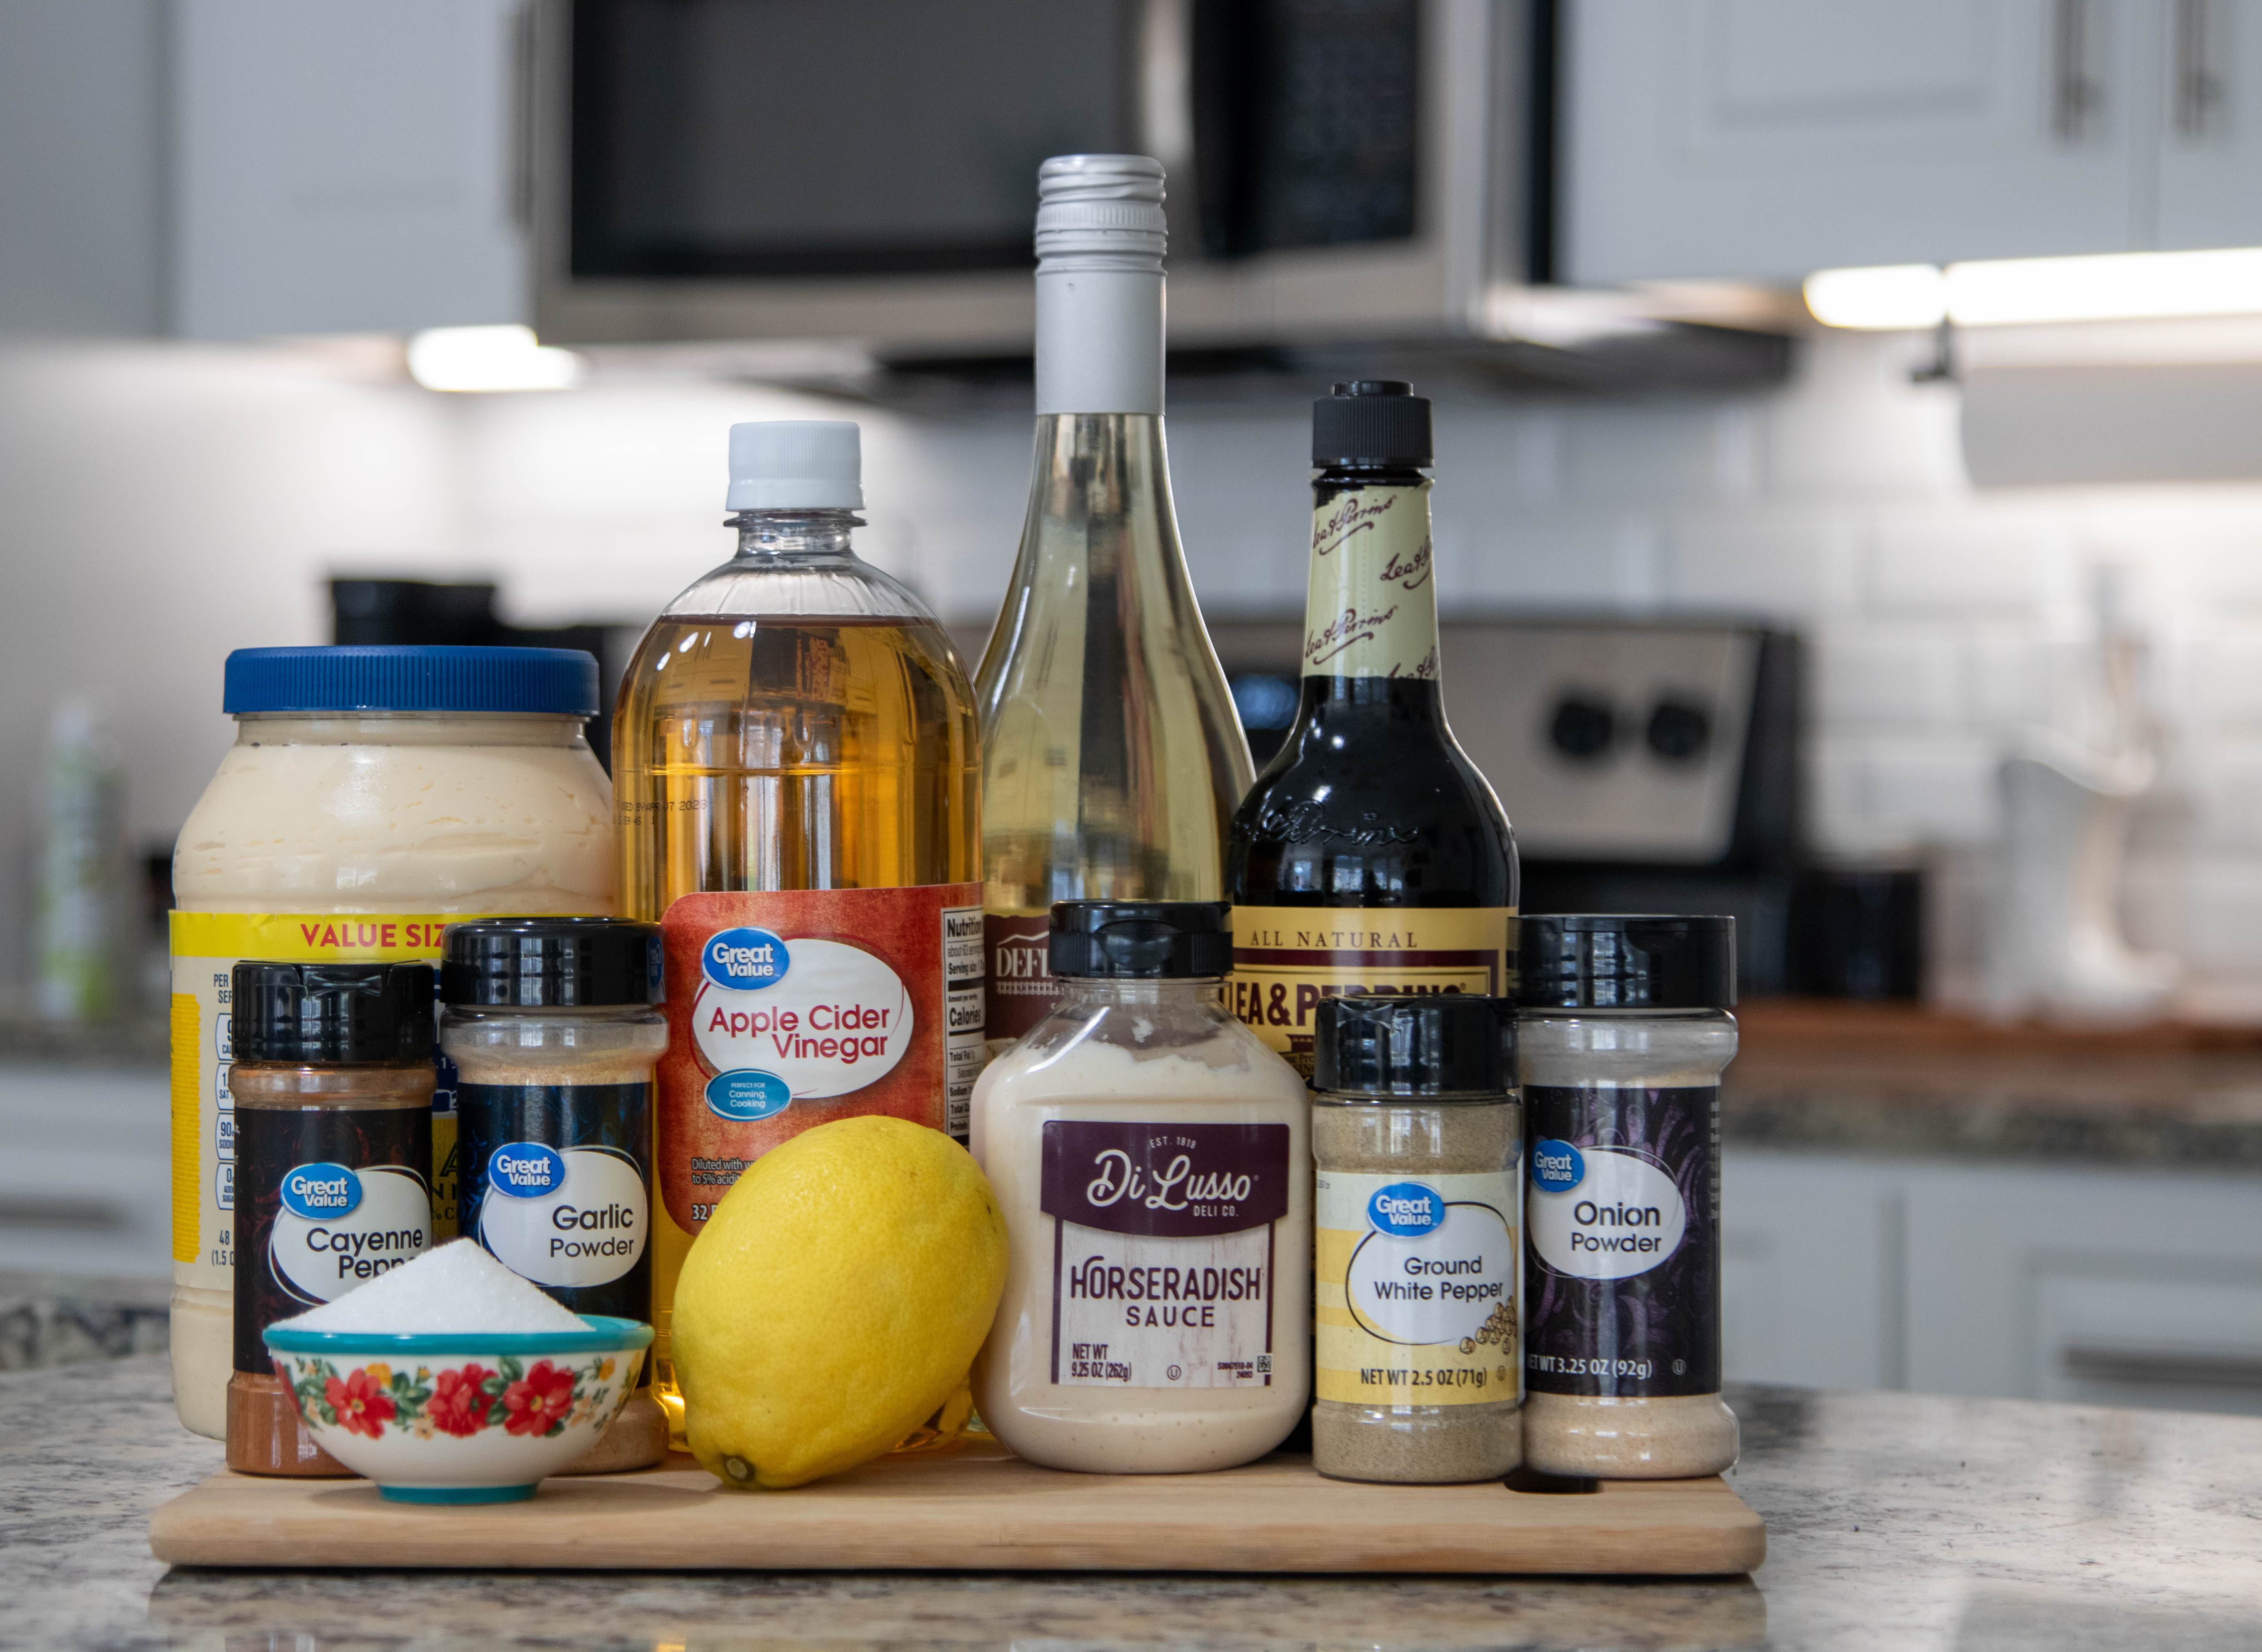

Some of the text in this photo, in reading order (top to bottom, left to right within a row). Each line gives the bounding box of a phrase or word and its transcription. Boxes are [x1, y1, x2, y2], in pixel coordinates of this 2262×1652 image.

[300, 924, 445, 947] VALUE SIZ
[1252, 930, 1418, 948] ALL NATURAL
[712, 942, 774, 964] Great
[726, 961, 774, 978] Value
[214, 974, 229, 987] PER
[709, 1004, 890, 1038] Apple Cider
[950, 1004, 981, 1027] Calories
[772, 1033, 889, 1064] Vinegar
[730, 1099, 766, 1109] Cooking
[1149, 1136, 1173, 1148] EST.
[496, 1154, 551, 1175] Great
[691, 1157, 722, 1170] Diluted
[723, 1157, 743, 1170] with
[1534, 1151, 1573, 1170] Great
[508, 1172, 551, 1187] Value
[692, 1172, 740, 1185] to 5% acidi
[1543, 1168, 1573, 1182] Value
[291, 1175, 348, 1196] Great
[304, 1193, 348, 1208] Value
[1376, 1194, 1431, 1214] Great
[552, 1203, 633, 1231] Garlic
[692, 1204, 708, 1220] 32
[1193, 1205, 1239, 1217] DELI CO.
[1389, 1211, 1431, 1227] Value
[1574, 1200, 1661, 1227] Onion
[219, 1230, 230, 1245] 48
[306, 1227, 423, 1257] Cayenne
[550, 1237, 634, 1258] Powder
[1571, 1232, 1661, 1253] Powder
[212, 1249, 226, 1267] (1.5
[1405, 1256, 1482, 1275] Ground
[1070, 1255, 1261, 1301] HORSERADISH
[1374, 1281, 1503, 1303] White Pepper
[1126, 1306, 1215, 1328] SAUCE
[1072, 1343, 1109, 1360] NET WT
[1071, 1361, 1132, 1382] 9.25 OZ (262g)
[1539, 1354, 1556, 1372] WT
[1557, 1357, 1586, 1374] 3.25
[1589, 1358, 1609, 1376] OZ
[1612, 1358, 1653, 1380] (92g)
[1361, 1367, 1488, 1388] NET WT 2.5 OZ (71g)
